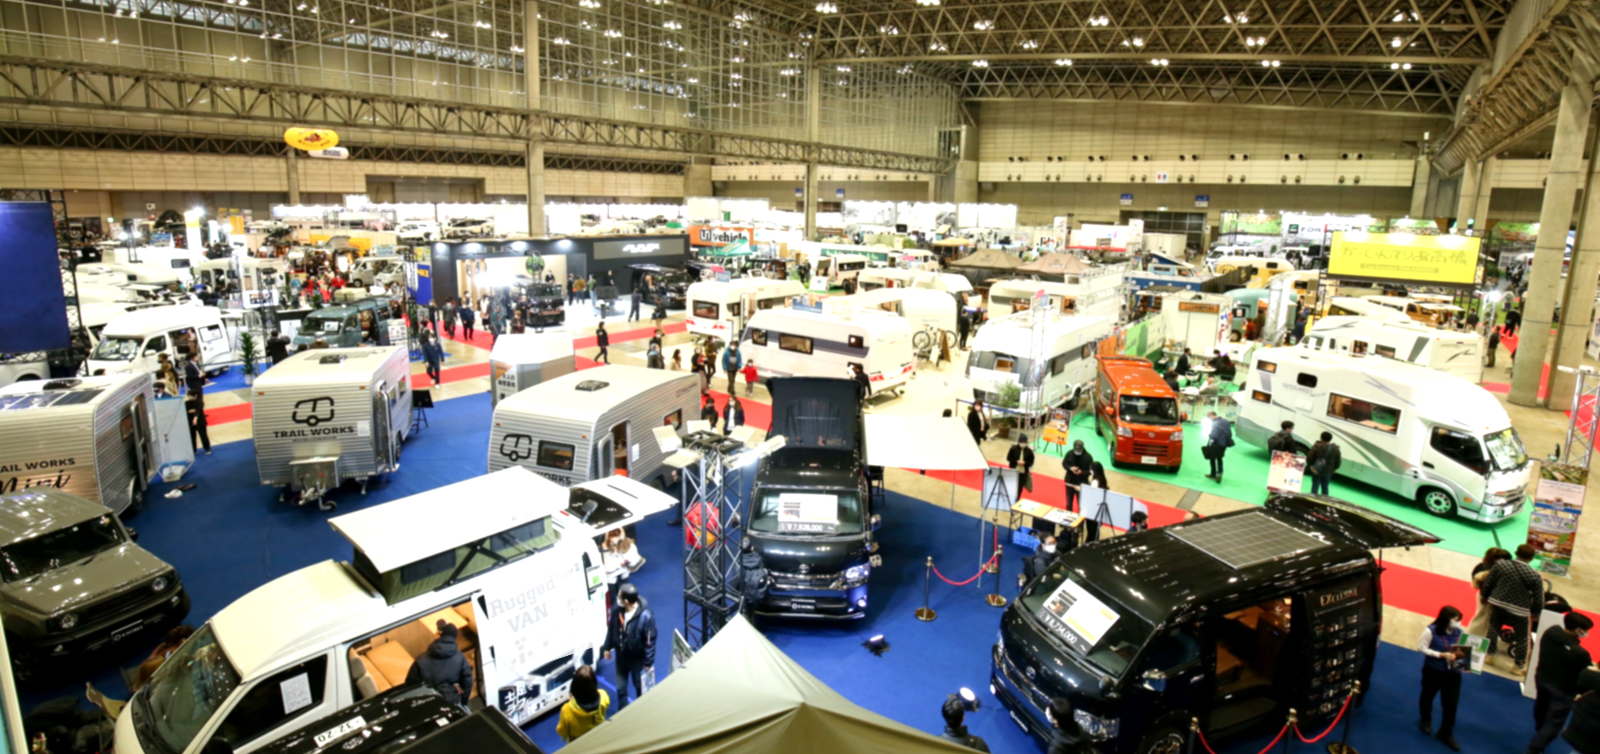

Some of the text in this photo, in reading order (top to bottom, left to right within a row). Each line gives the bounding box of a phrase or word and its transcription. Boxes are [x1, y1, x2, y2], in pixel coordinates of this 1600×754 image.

[274, 426, 354, 438] TRAIL WORKS
[25, 457, 75, 470] WORKS
[488, 576, 556, 618] Rugged
[507, 602, 549, 633] VAN
